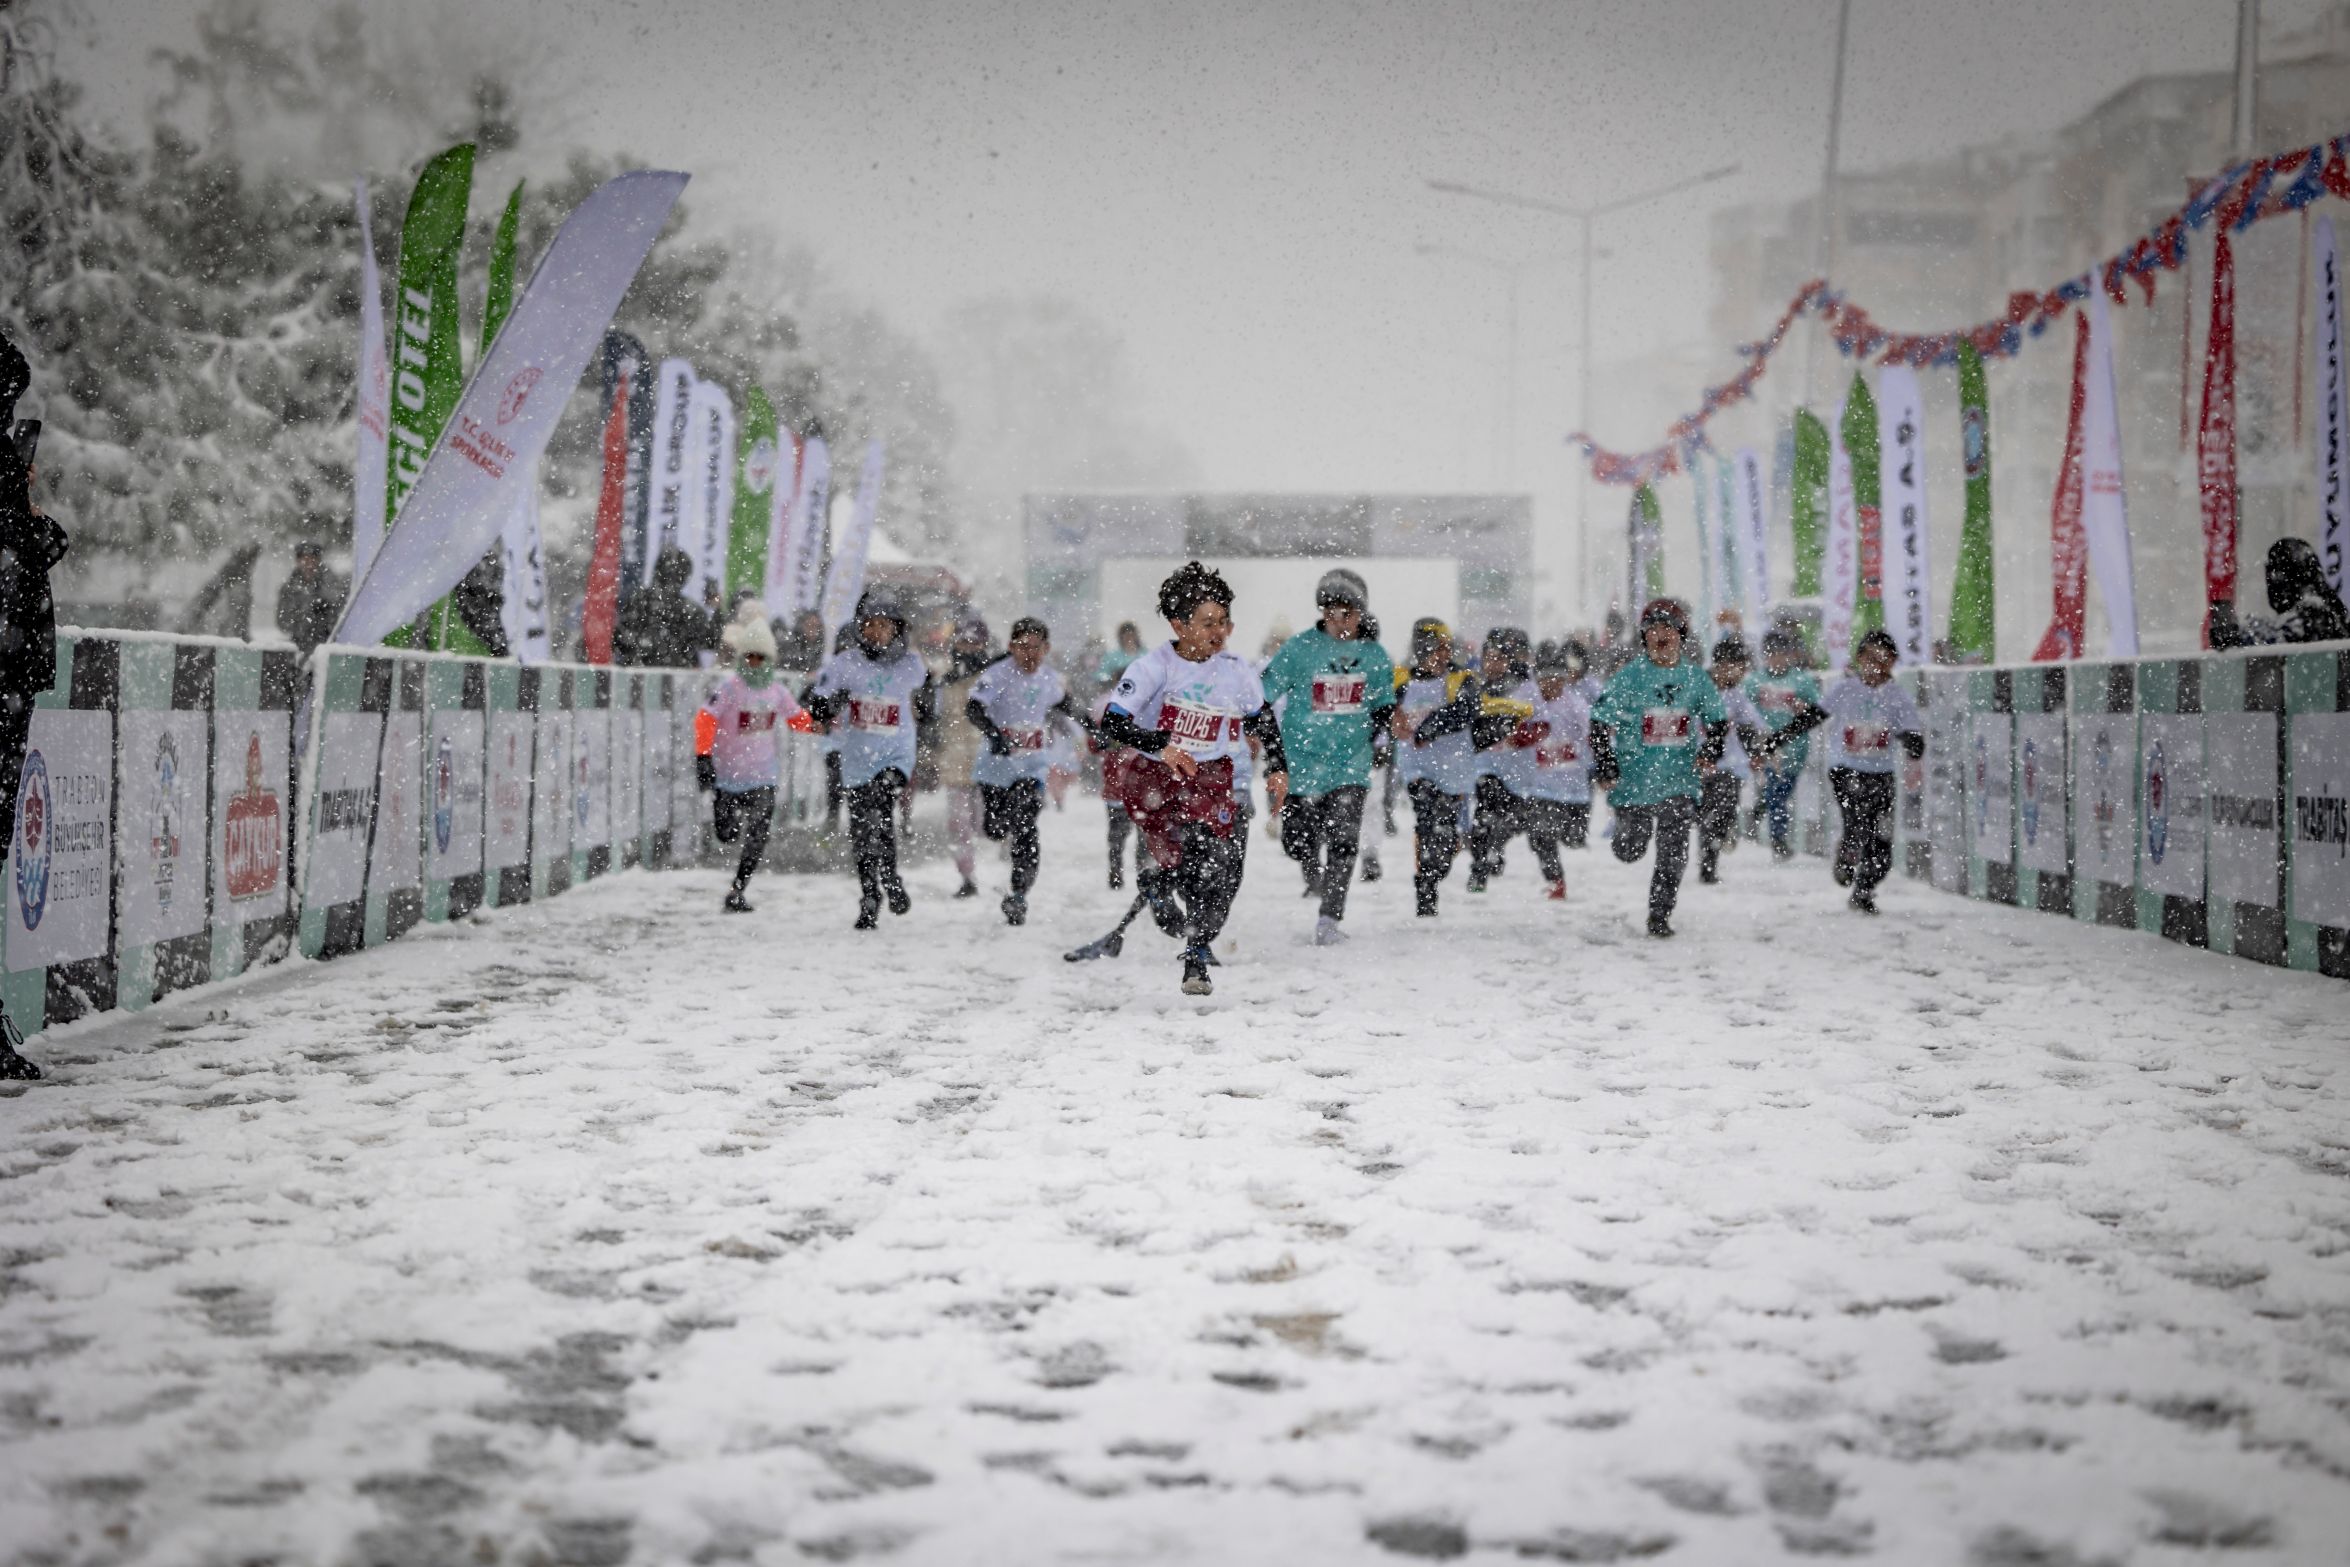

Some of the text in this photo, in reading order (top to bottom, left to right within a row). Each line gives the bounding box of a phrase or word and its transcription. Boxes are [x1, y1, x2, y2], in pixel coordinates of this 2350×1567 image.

[398, 286, 432, 411] OTEL
[1174, 710, 1212, 738] 6076
[55, 775, 105, 805] TRABZON
[54, 814, 104, 857] BÜYÜKŞEHİR
[53, 861, 103, 901] BELEDİYESİ
